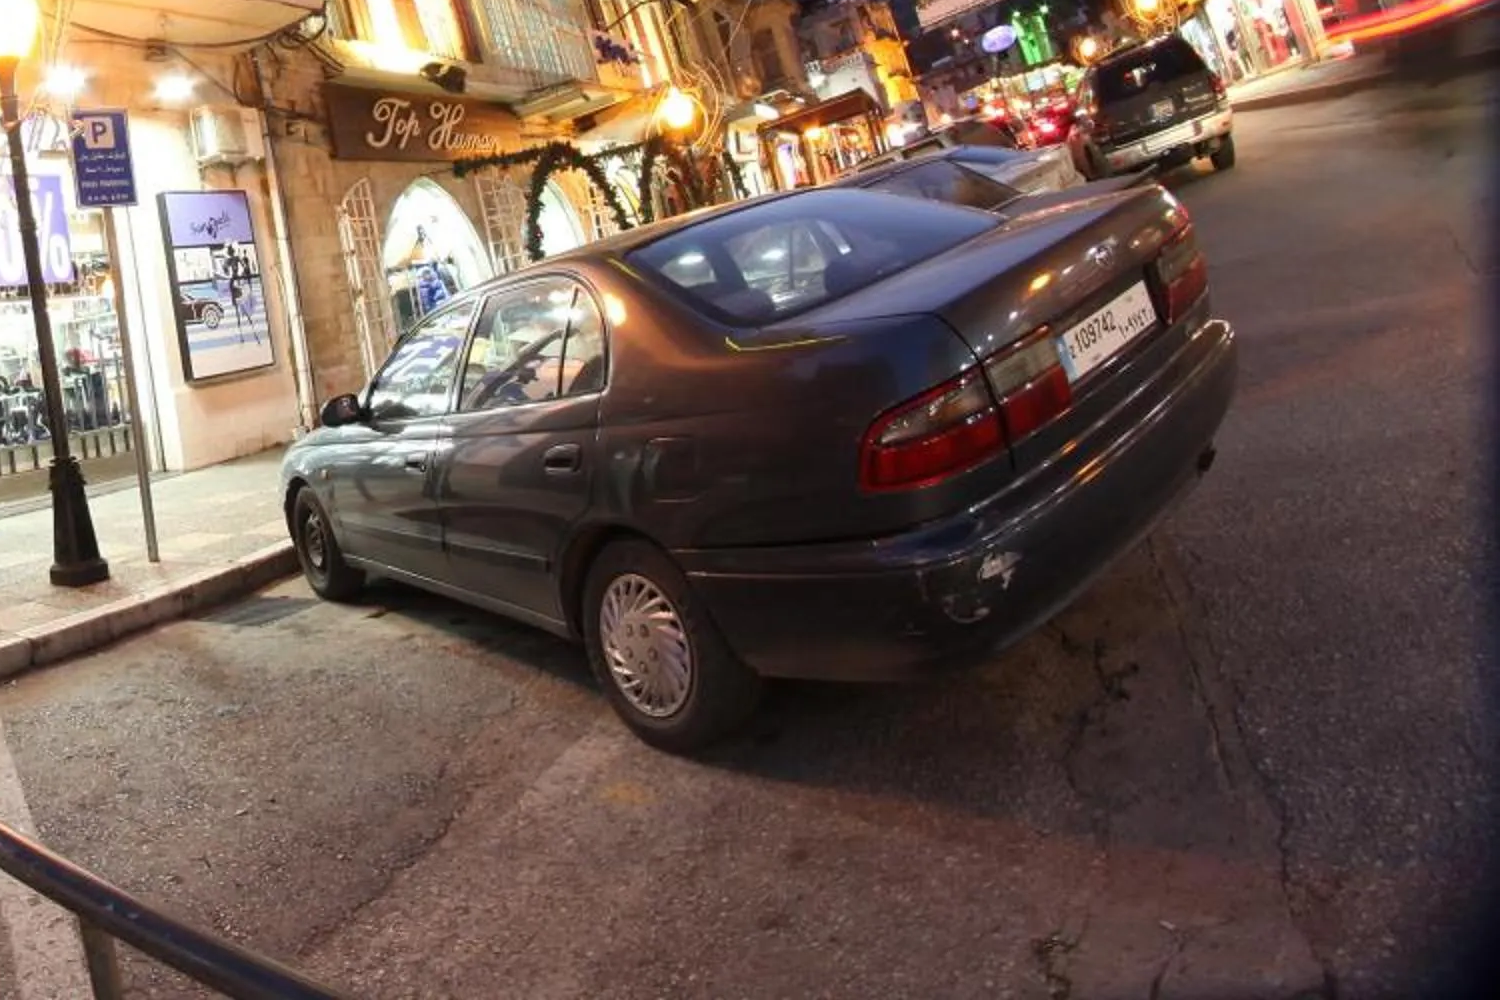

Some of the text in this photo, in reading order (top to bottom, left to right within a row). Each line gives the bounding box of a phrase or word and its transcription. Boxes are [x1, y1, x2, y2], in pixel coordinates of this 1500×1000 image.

[91, 121, 107, 144] P
[366, 97, 421, 149] Top
[1074, 310, 1117, 353] 109742
